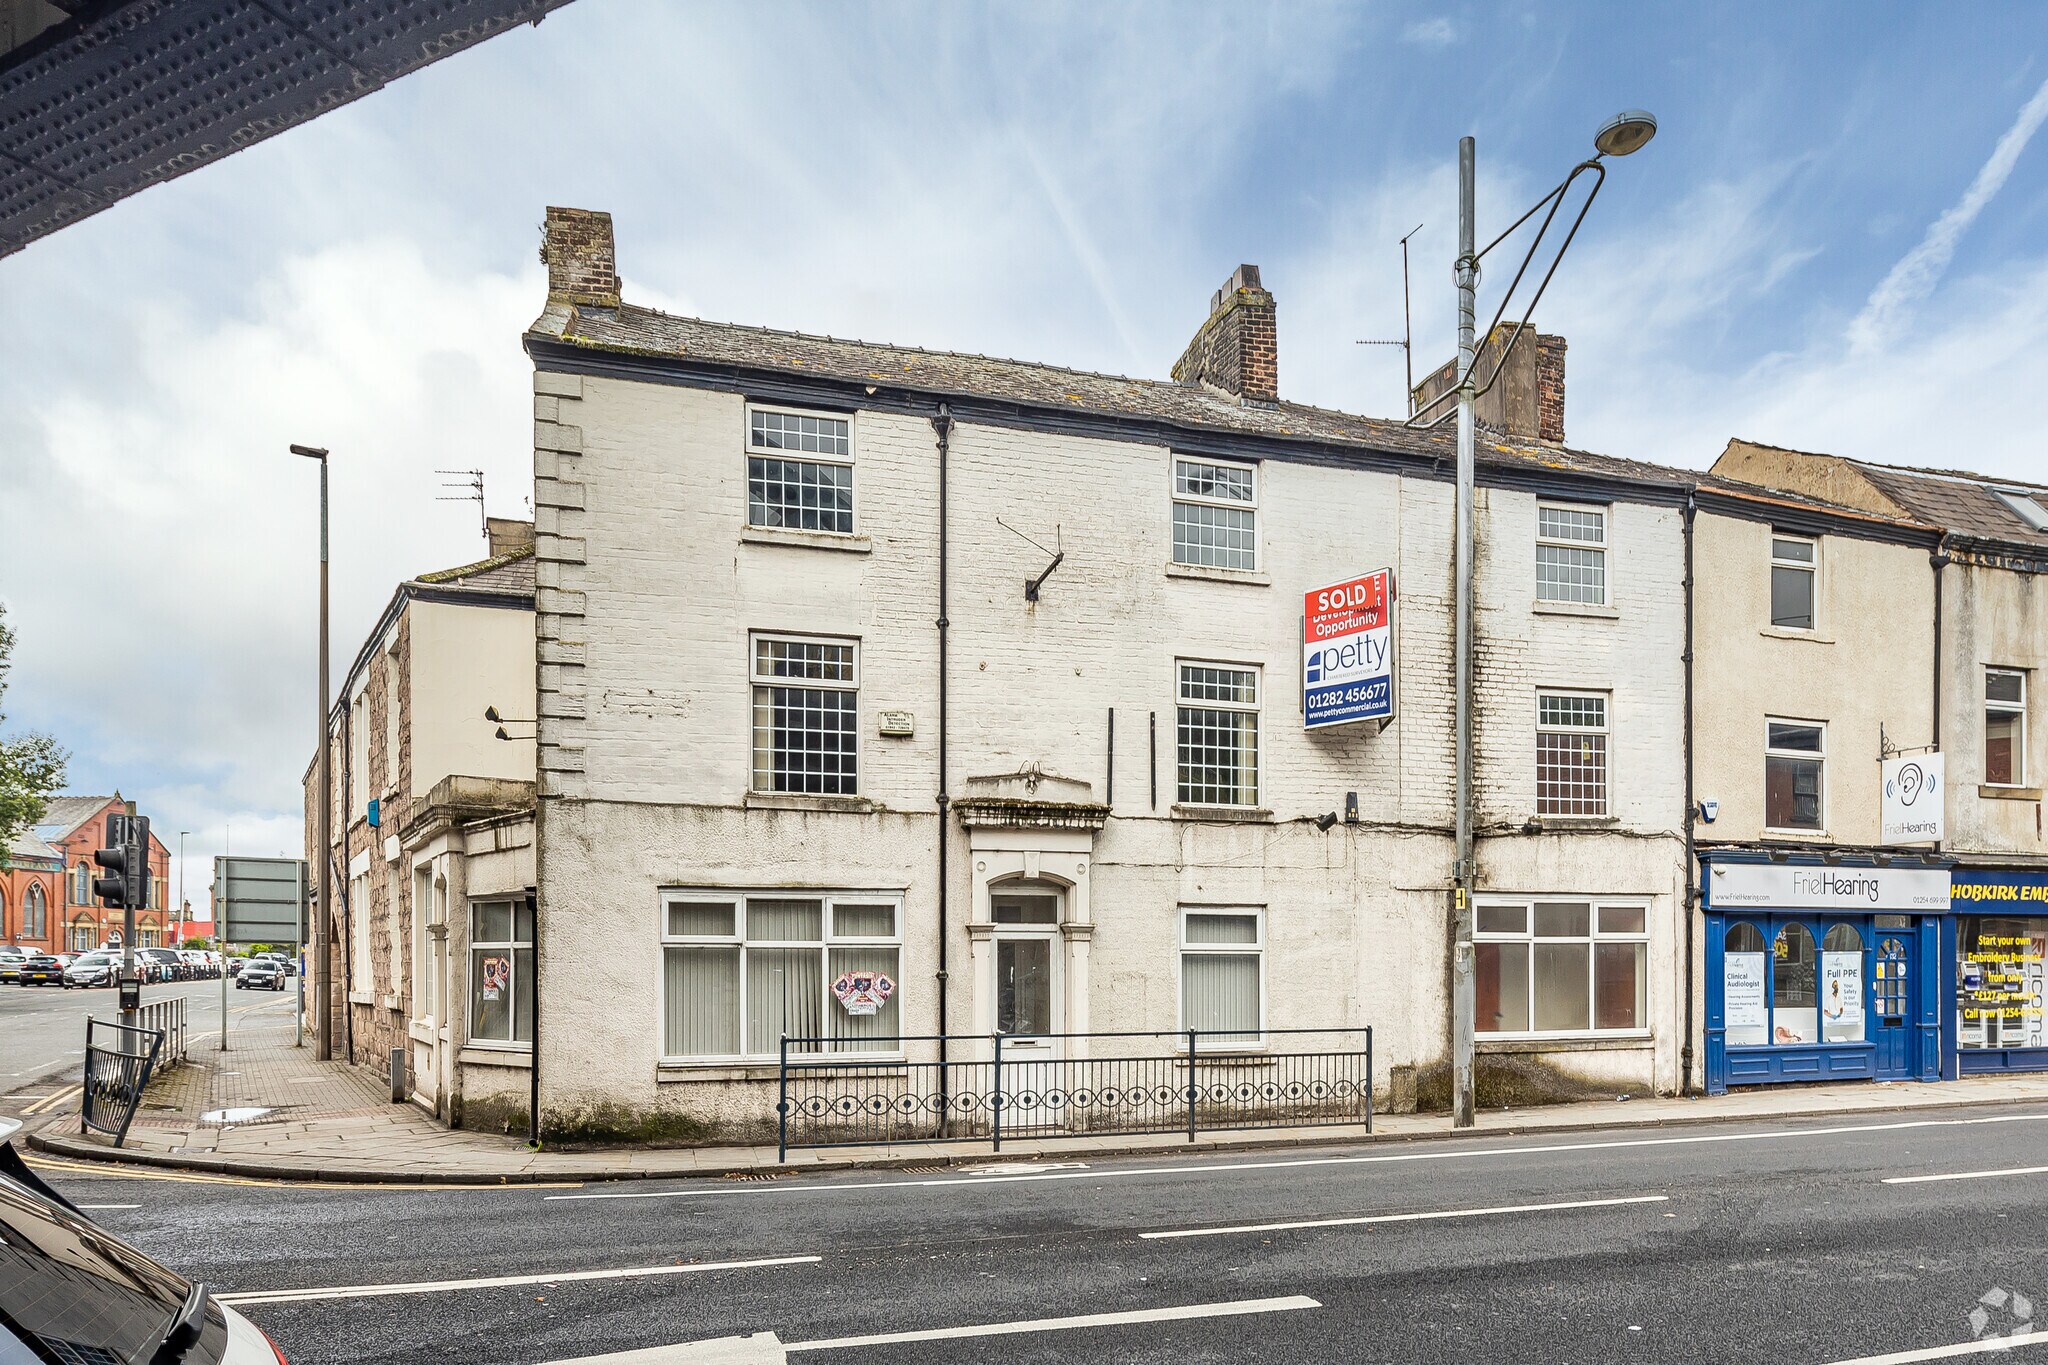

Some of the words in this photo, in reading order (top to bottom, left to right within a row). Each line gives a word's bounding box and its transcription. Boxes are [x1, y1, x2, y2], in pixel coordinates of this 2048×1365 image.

[1318, 584, 1366, 612] SOLD
[1316, 612, 1378, 637] Opportunity
[1323, 634, 1388, 680] petty
[1308, 691, 1343, 709] 01282
[1345, 682, 1387, 703] 456677
[1308, 699, 1387, 719] www.pettycommercial.co.uk
[1885, 820, 1937, 835] FrielHearing
[1793, 871, 1879, 902] FrielHearing
[1951, 884, 2018, 902] HOBKIRK
[1978, 934, 1997, 946] Start
[1997, 936, 2014, 948] your
[2015, 937, 2031, 946] own
[1967, 952, 2010, 964] Embroidery
[1827, 969, 1841, 978] Full
[1843, 969, 1858, 978] PPE
[1988, 972, 2006, 983] from
[2007, 973, 2023, 984] only
[1964, 1008, 1979, 1019] Call
